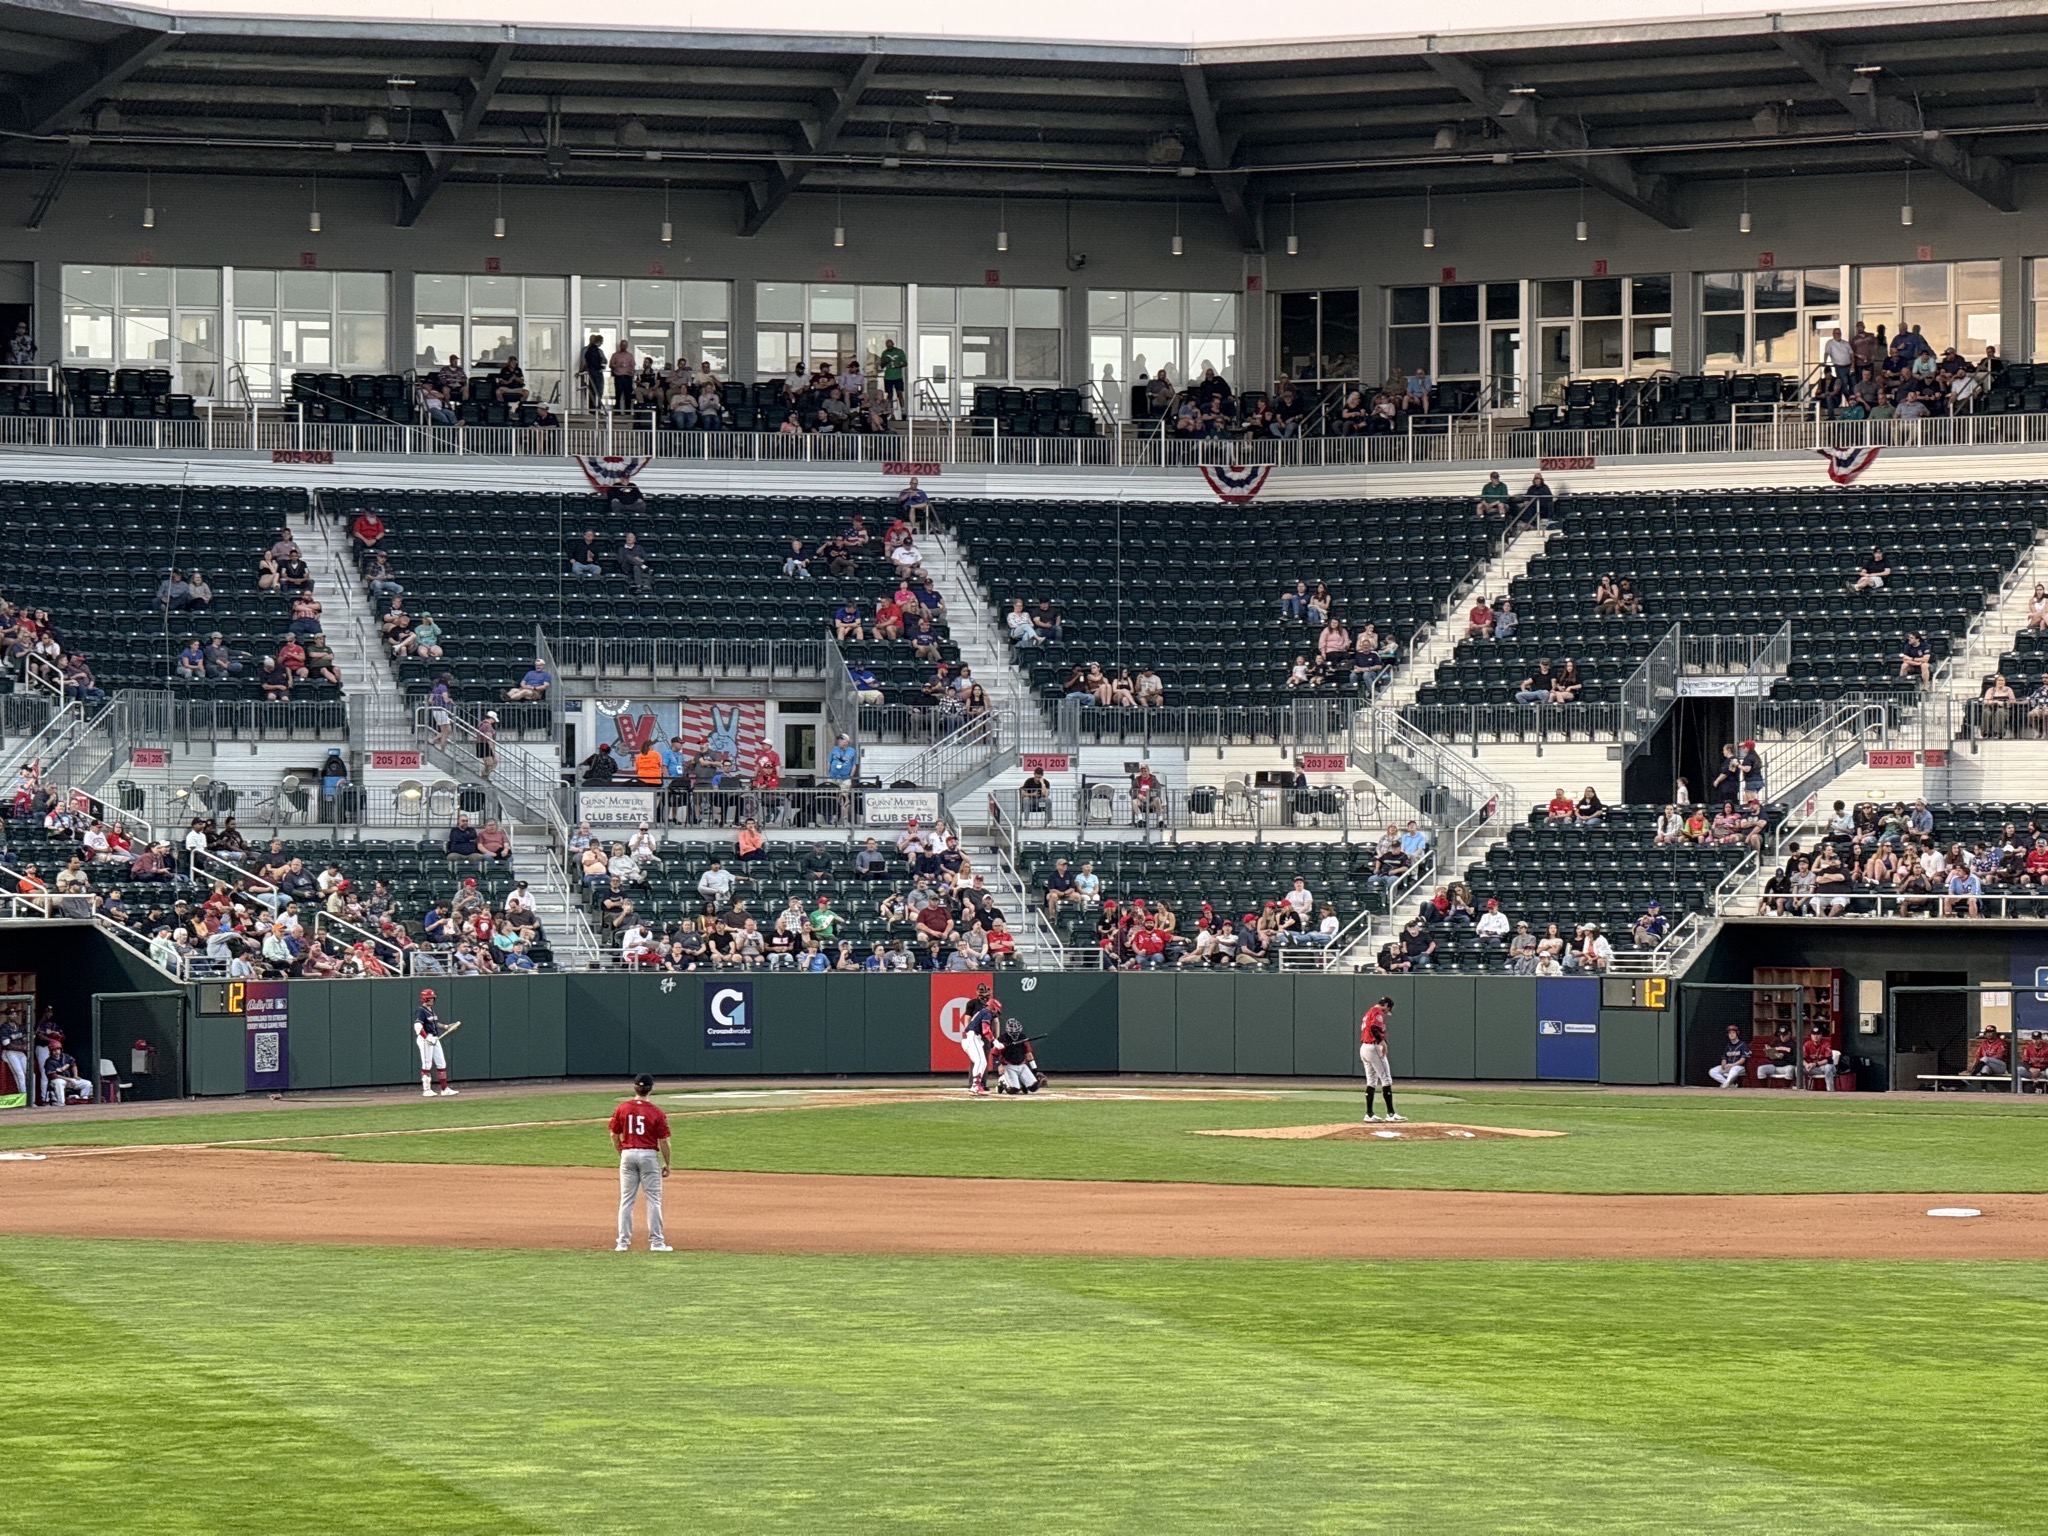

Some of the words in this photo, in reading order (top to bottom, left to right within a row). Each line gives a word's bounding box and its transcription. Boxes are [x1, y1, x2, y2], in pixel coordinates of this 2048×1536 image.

[274, 452, 301, 464] 205
[305, 452, 333, 464] 204
[884, 463, 910, 475] 204
[913, 463, 941, 475] 203
[1541, 459, 1566, 471] 203
[1569, 458, 1594, 470] 202
[136, 755, 148, 763] 206
[152, 755, 163, 763] 205
[376, 756, 393, 765] 205
[400, 756, 417, 765] 204
[1026, 759, 1043, 768] 204
[1050, 759, 1066, 768] 203
[1306, 760, 1322, 768] 203
[1328, 760, 1343, 768] 202
[1872, 756, 1889, 765] 202
[1895, 755, 1911, 764] 201
[609, 796, 645, 806] MOWERY
[894, 797, 929, 807] MOWERY
[585, 813, 613, 821] CLUB
[615, 813, 648, 821] SEATS
[871, 814, 898, 822] CLUB
[901, 813, 933, 822] SEATS
[229, 982, 244, 1013] 12
[1644, 978, 1666, 1008] 12
[628, 1114, 645, 1135] 15
